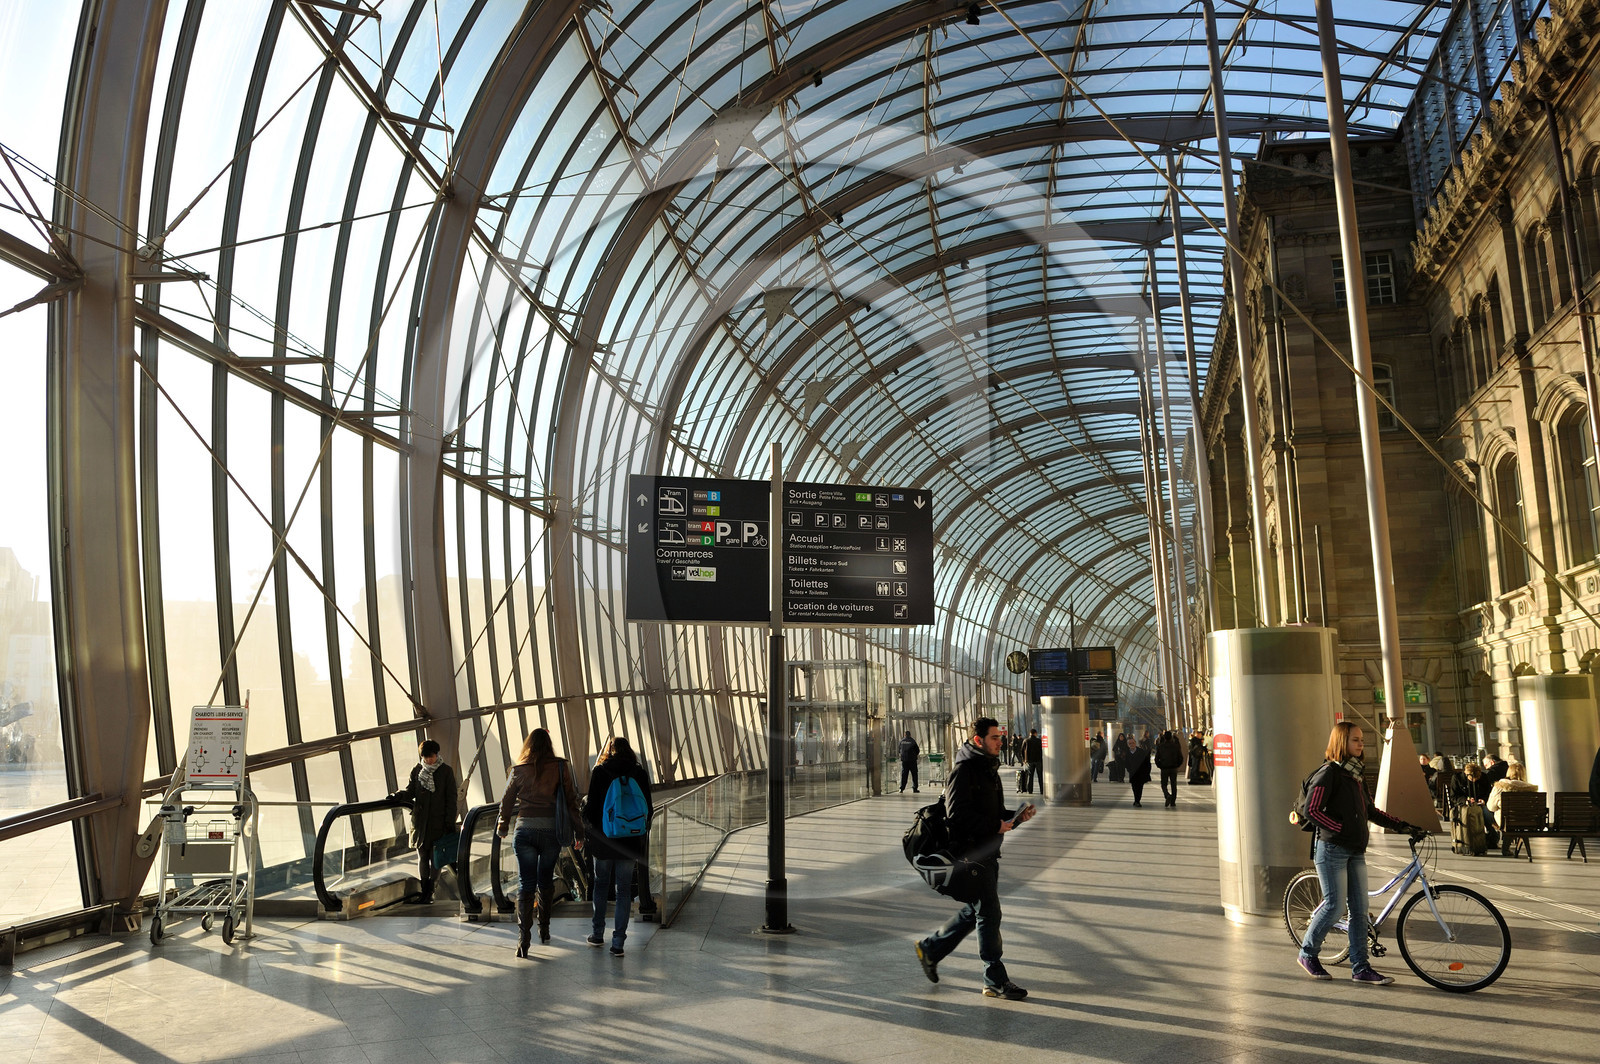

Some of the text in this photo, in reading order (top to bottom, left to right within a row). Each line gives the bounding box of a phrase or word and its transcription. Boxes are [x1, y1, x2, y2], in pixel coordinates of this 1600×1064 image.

[711, 492, 718, 500] B
[788, 489, 816, 499] Sortie
[710, 507, 716, 515] F
[816, 515, 824, 526] P
[834, 516, 842, 526] P
[860, 516, 868, 527] P
[704, 523, 712, 531] A
[716, 522, 732, 543] P
[743, 522, 758, 543] P
[704, 536, 711, 544] D
[789, 534, 824, 543] Accueil
[656, 548, 714, 558] Commerces
[788, 556, 818, 565] Billets
[789, 578, 828, 588] Toilettes
[788, 602, 874, 612] Location de voitures
